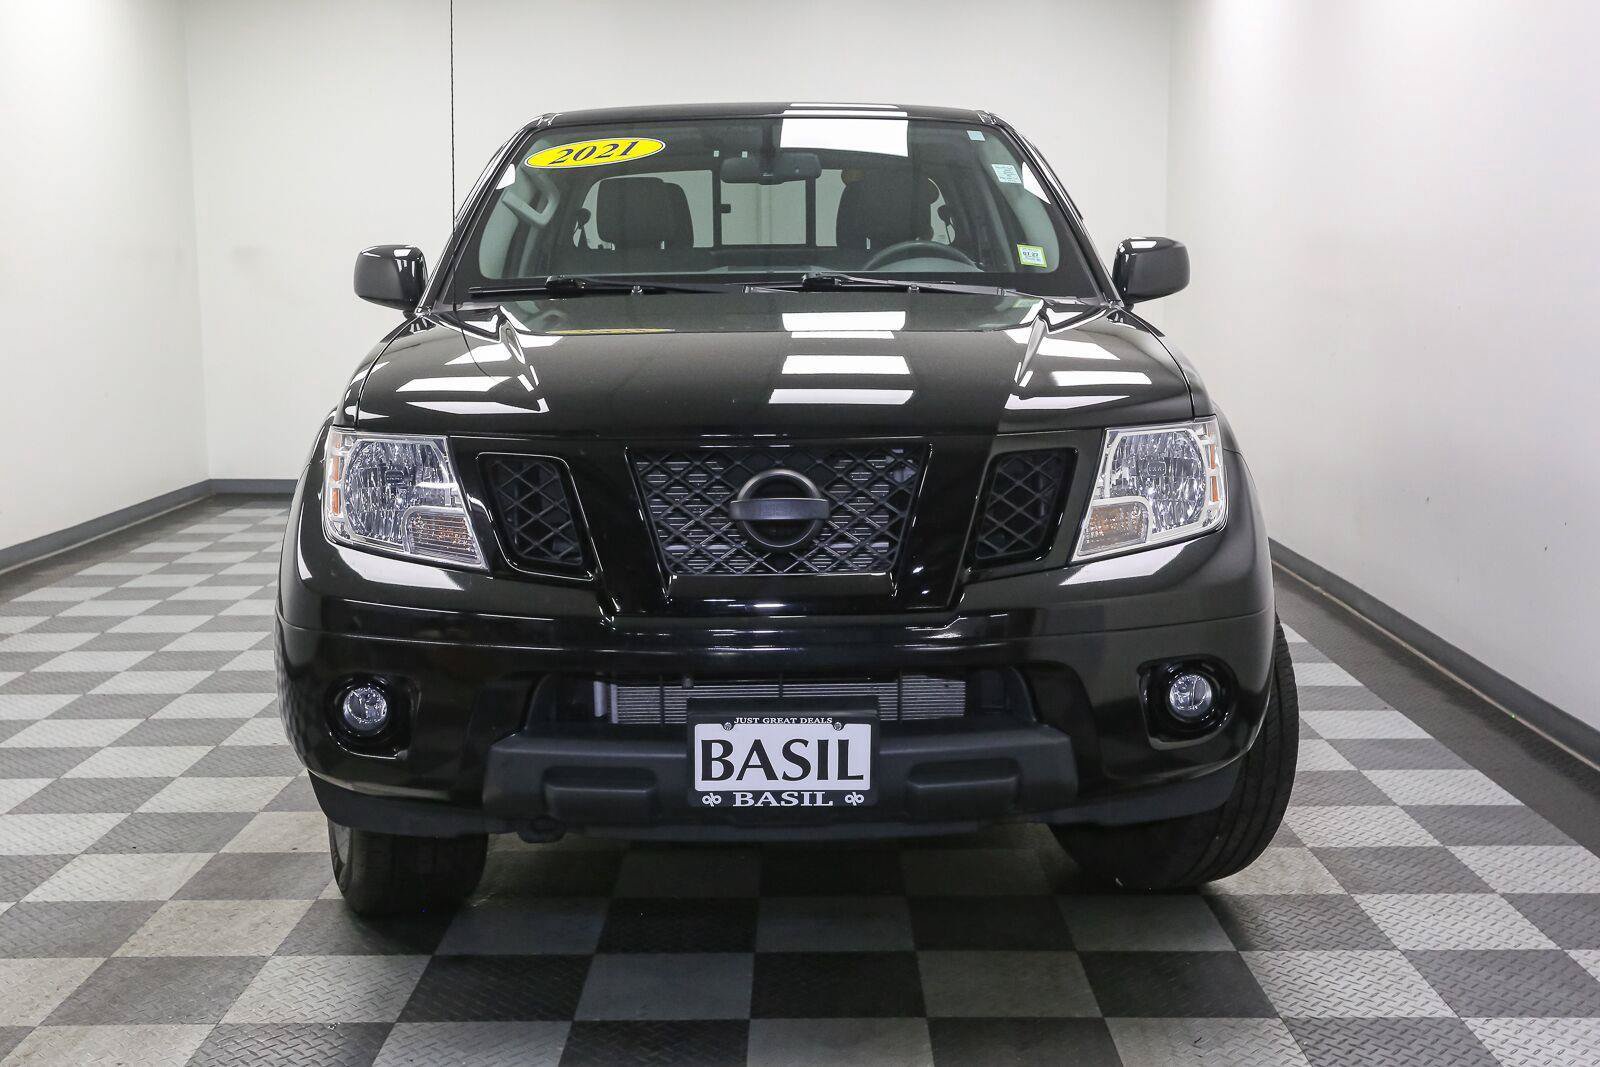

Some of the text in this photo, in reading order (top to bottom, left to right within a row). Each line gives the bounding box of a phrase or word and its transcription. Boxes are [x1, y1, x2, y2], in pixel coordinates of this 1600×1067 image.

[548, 141, 639, 165] 2021
[701, 738, 864, 781] BASIL
[732, 791, 834, 807] BASIL
